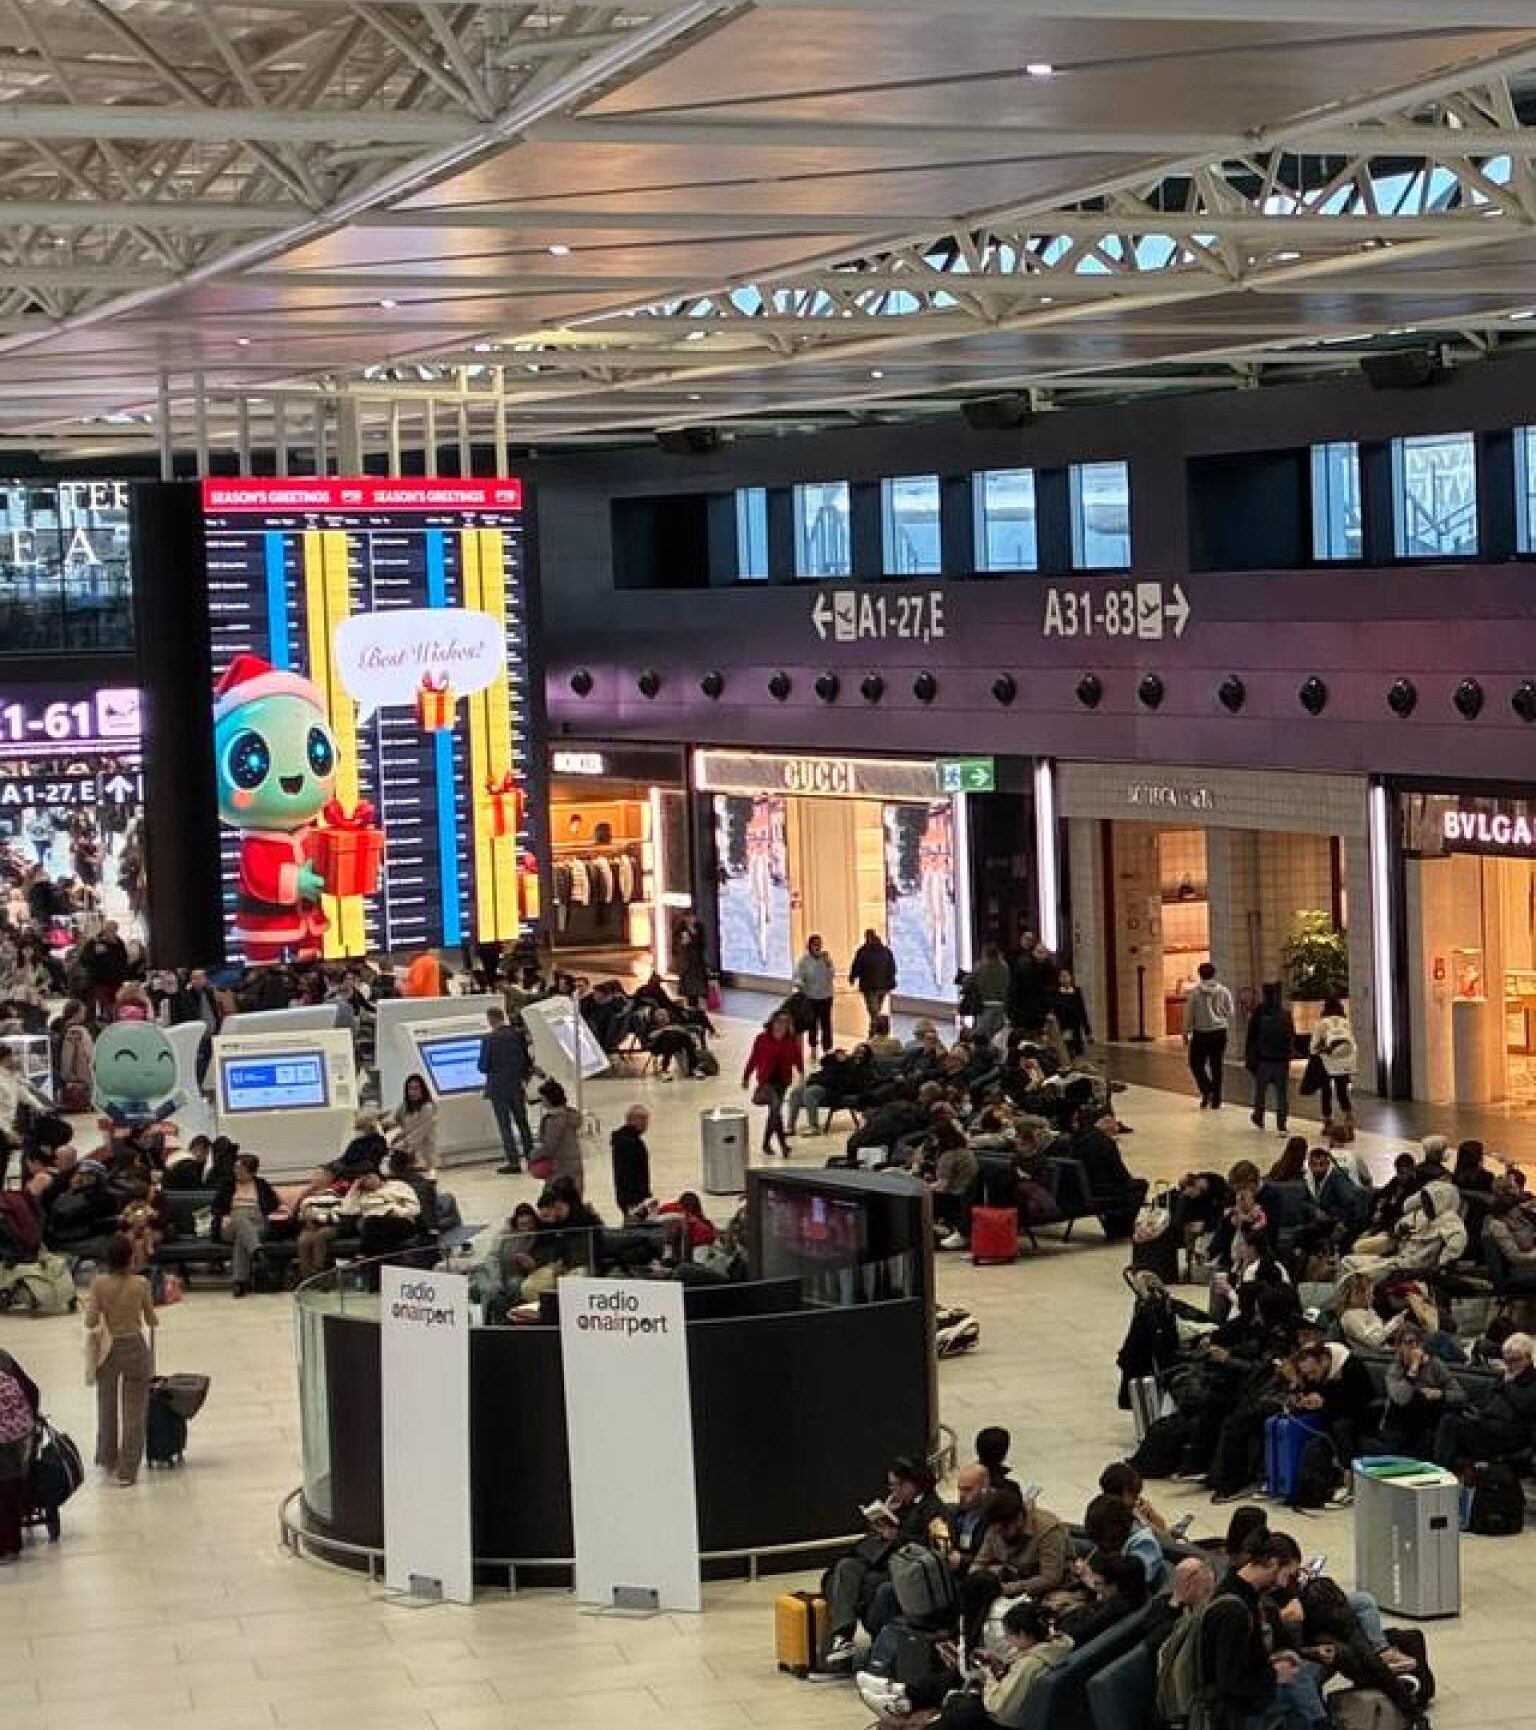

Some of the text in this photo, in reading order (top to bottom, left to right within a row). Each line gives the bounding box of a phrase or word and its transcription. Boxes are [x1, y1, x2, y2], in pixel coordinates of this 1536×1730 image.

[858, 591, 944, 643] A1-27,E
[1044, 587, 1135, 637] A31-83
[358, 643, 406, 669] Best
[0, 700, 90, 740] 1-61
[783, 760, 855, 793] GUCCI
[401, 1282, 434, 1302] radio
[588, 1289, 639, 1312] radio
